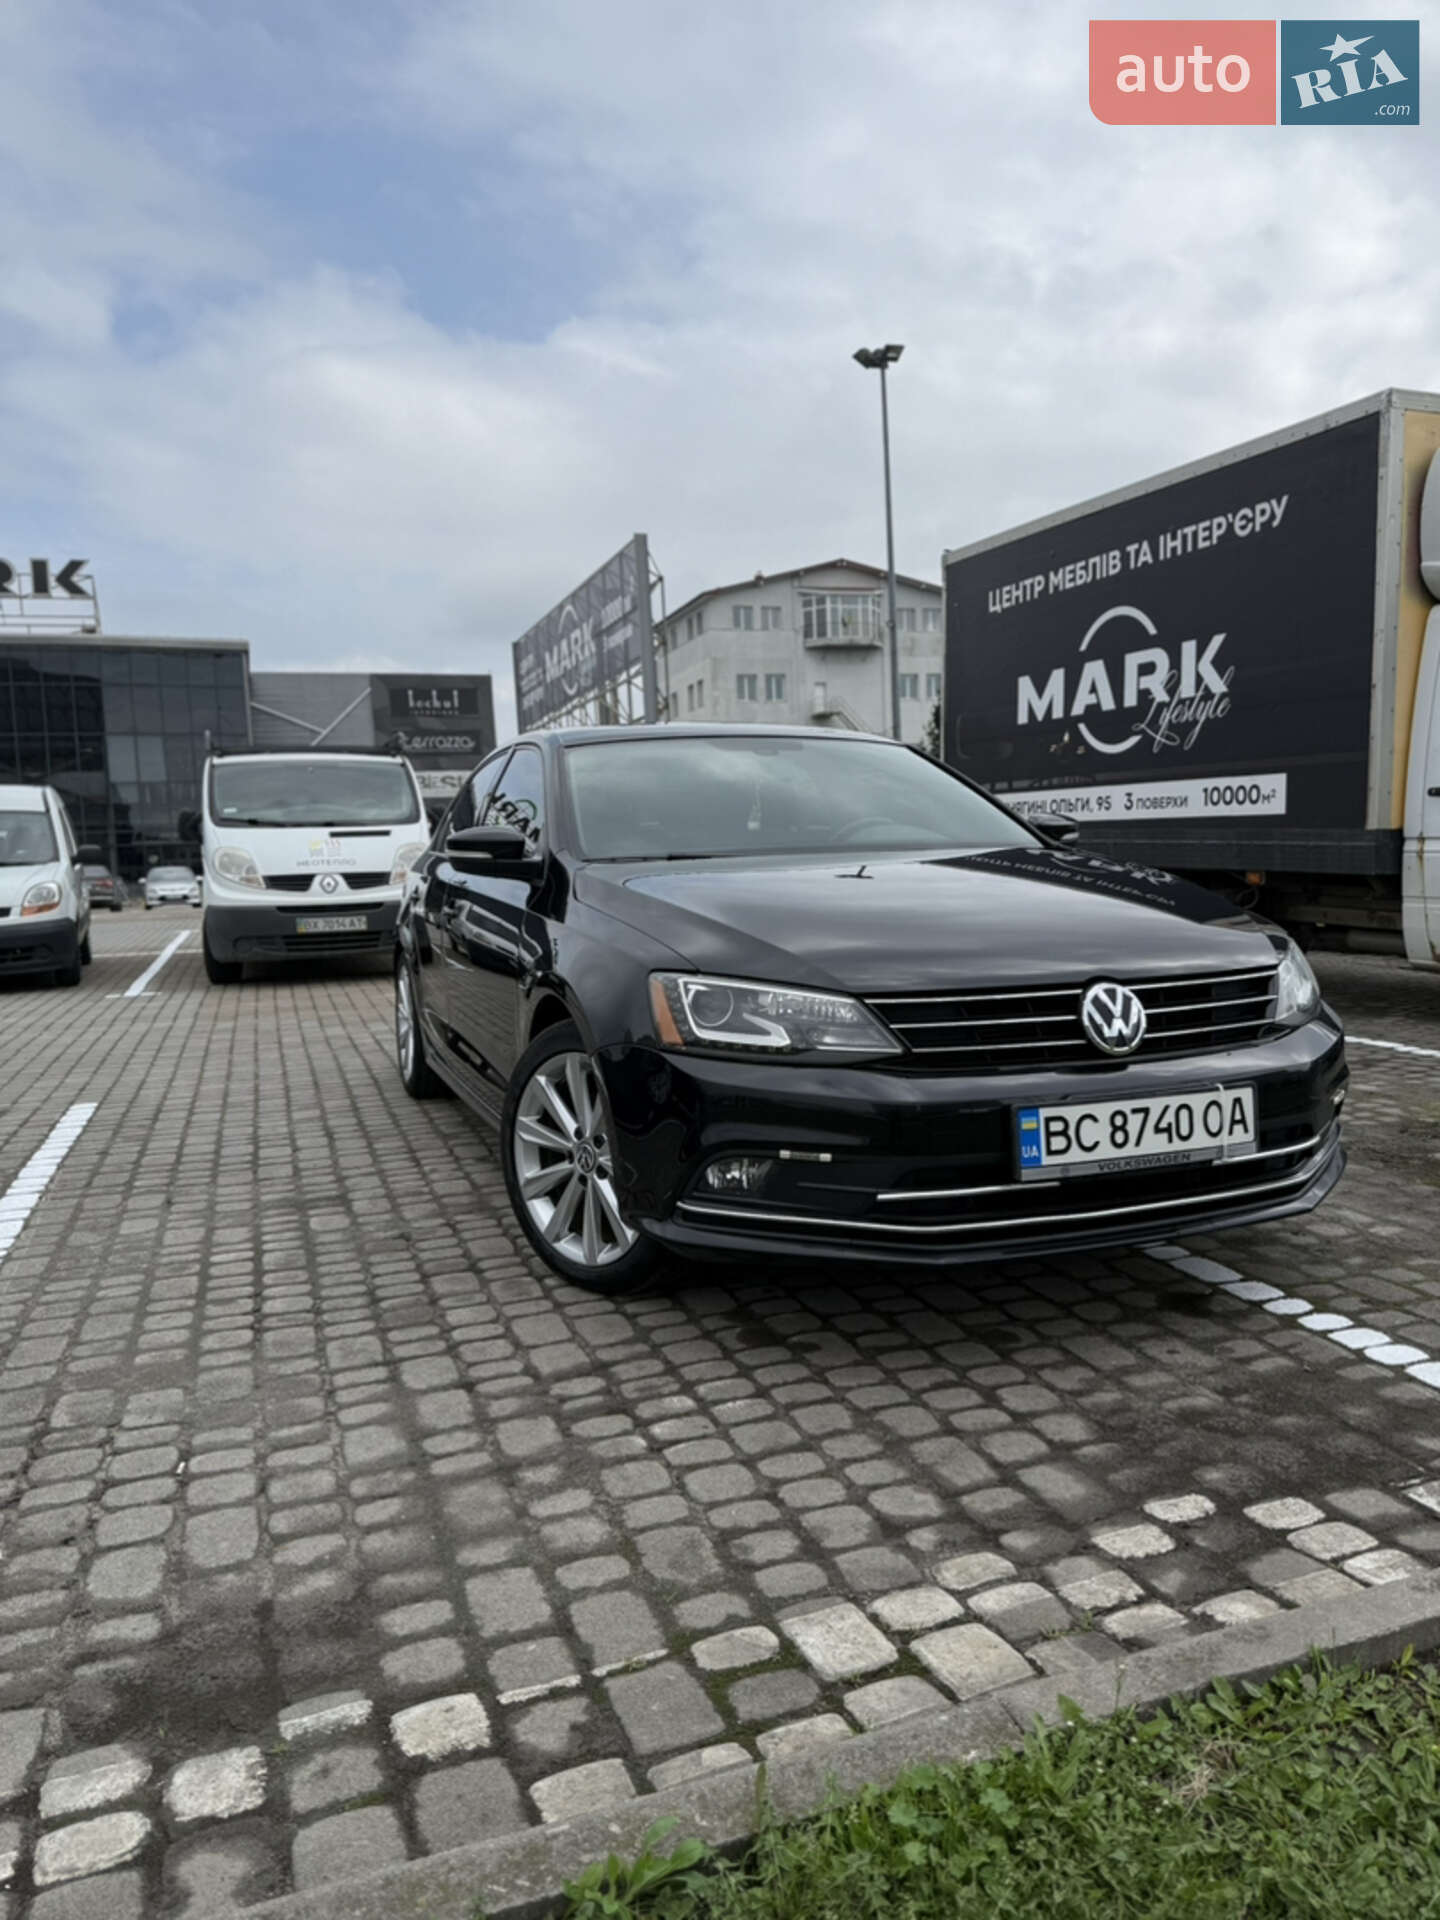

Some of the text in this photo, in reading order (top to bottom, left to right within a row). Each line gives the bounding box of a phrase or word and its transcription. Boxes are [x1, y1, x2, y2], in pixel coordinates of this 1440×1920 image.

[988, 574, 1046, 613] ЦЕНТР
[1048, 548, 1122, 595] МЕБЛІВ
[1125, 540, 1153, 570] ТА
[544, 617, 597, 683] MARK
[1016, 632, 1229, 726] MARK
[1131, 665, 1236, 754] Lifestyle
[1097, 795, 1112, 812] 95
[1124, 792, 1134, 811] 3
[1021, 1146, 1040, 1159] UA
[1044, 1096, 1249, 1157] BC 8740 OA
[1098, 1152, 1192, 1173] VOLKSWAGEN
